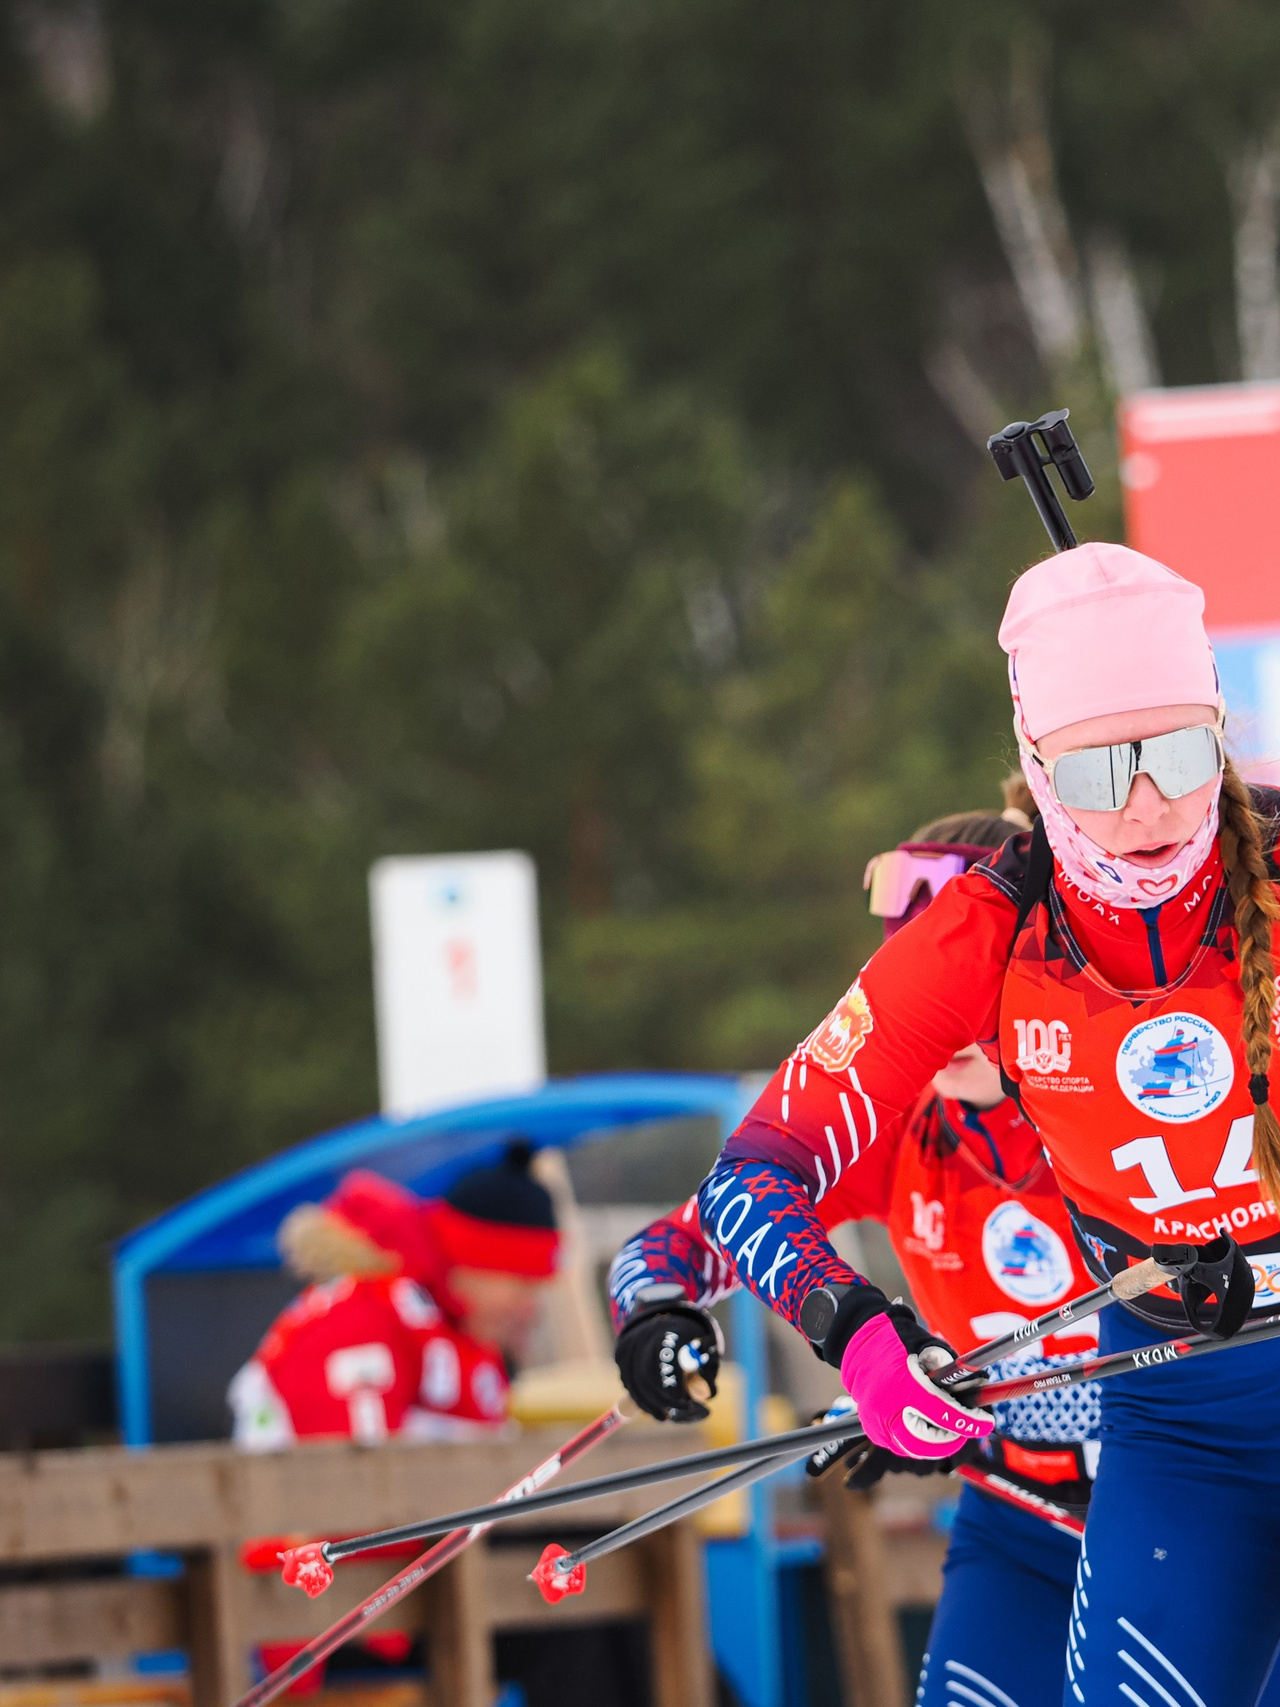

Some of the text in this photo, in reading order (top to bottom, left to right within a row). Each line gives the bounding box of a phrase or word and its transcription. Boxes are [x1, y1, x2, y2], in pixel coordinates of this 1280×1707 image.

[1121, 1015, 1214, 1054] ПЕРВЕНСТВО РОССИИ
[702, 1168, 798, 1299] MOAX
[659, 1331, 679, 1388] MOAX
[1132, 1344, 1178, 1368] MOAX
[1033, 1379, 1047, 1389] PRO
[1045, 1375, 1062, 1386] TEAM
